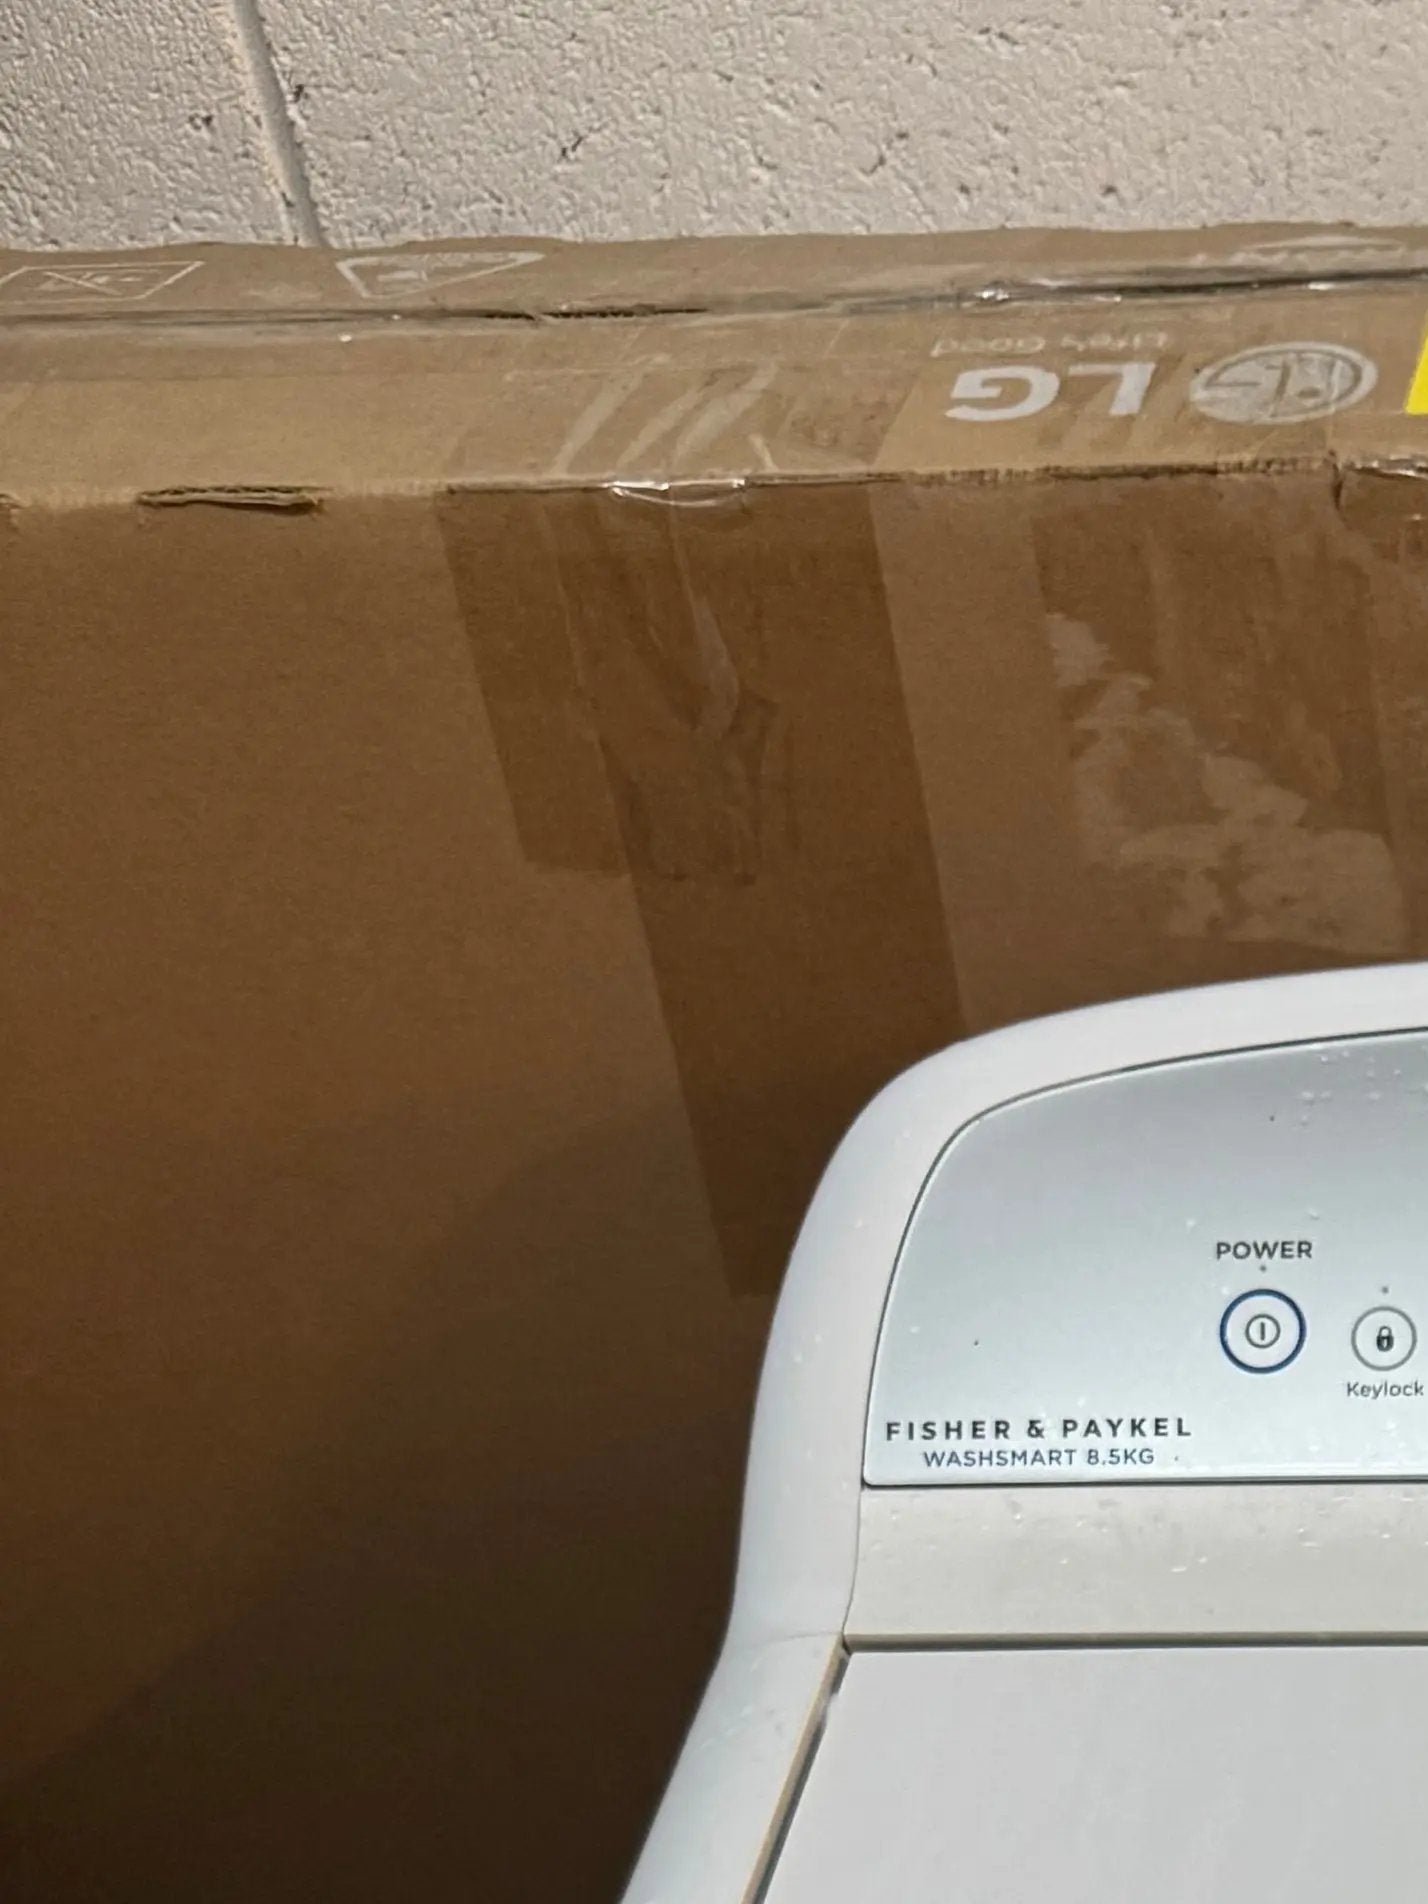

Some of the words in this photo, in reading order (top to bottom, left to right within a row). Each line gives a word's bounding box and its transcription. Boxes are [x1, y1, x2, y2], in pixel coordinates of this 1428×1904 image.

[944, 361, 1157, 423] LG
[1216, 1240, 1313, 1260] POWER
[1346, 1380, 1424, 1400] Keylock
[886, 1420, 1010, 1441] FISHER
[1026, 1419, 1045, 1439] &
[1062, 1417, 1192, 1439] PAYKEL
[923, 1449, 1077, 1468] WASHSMART
[1087, 1447, 1156, 1467] 8.5KG
